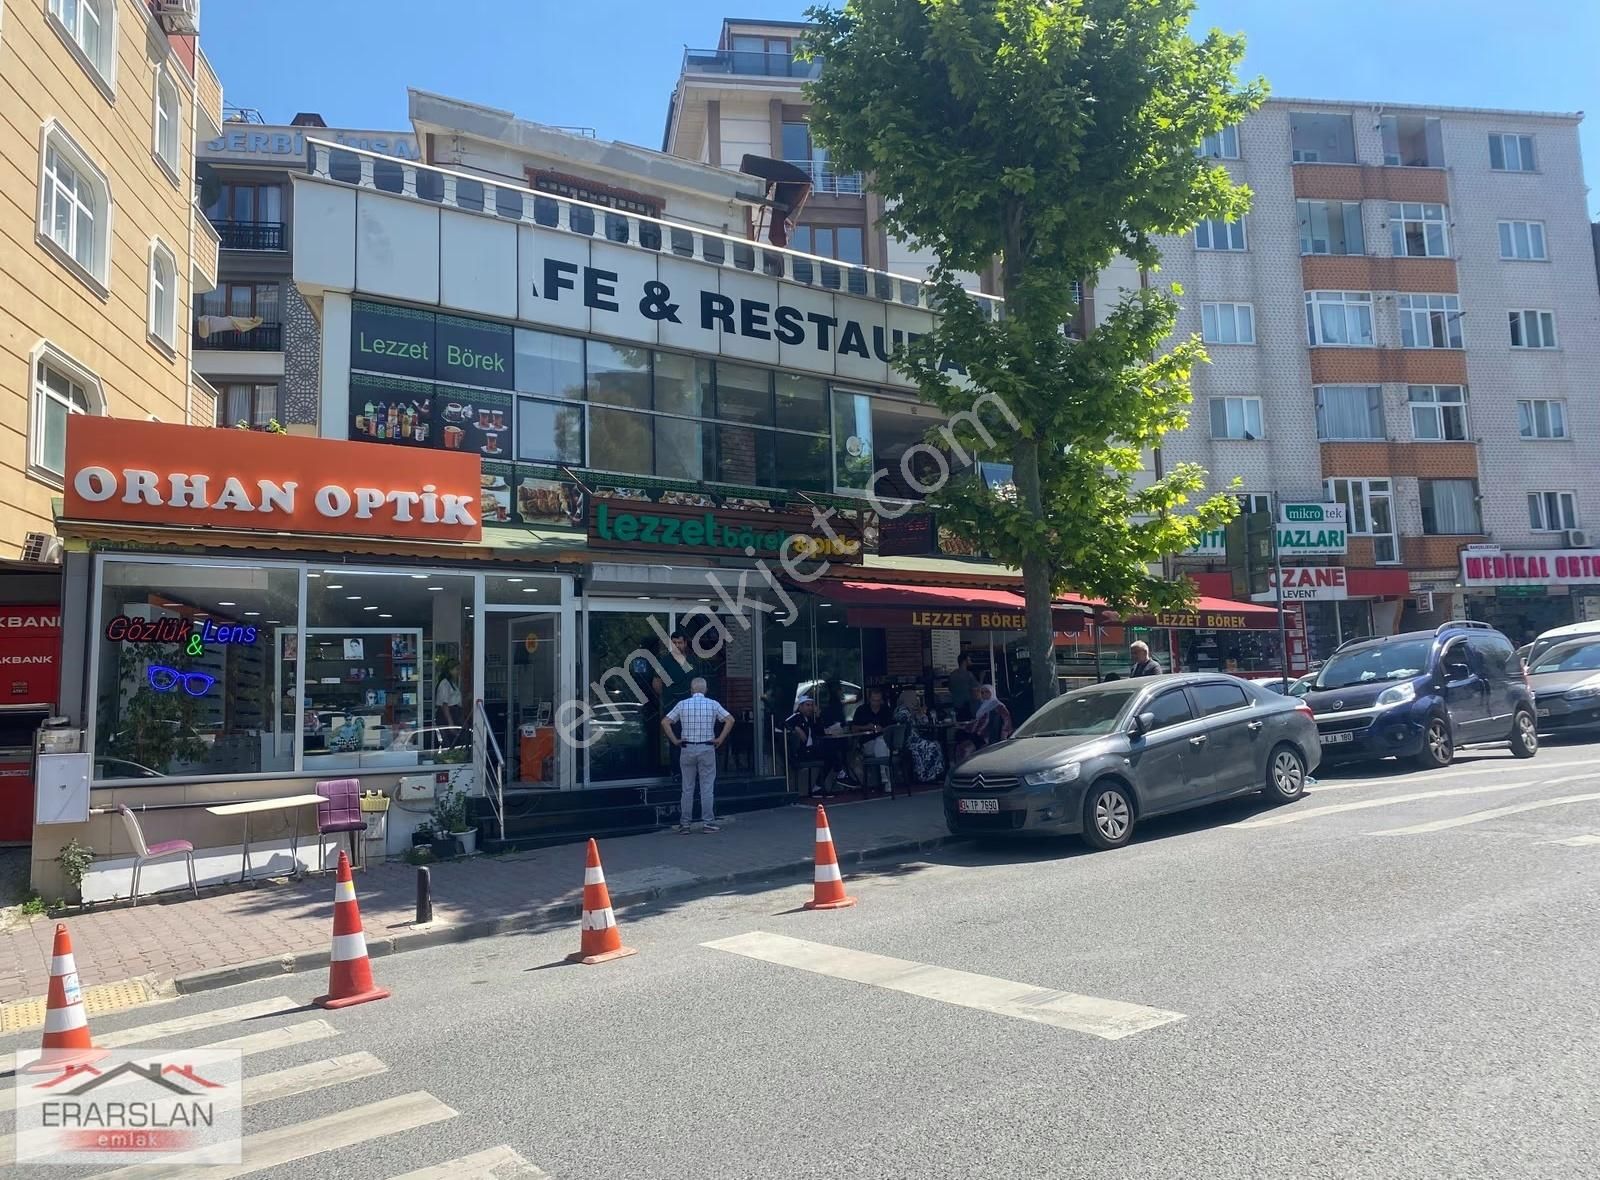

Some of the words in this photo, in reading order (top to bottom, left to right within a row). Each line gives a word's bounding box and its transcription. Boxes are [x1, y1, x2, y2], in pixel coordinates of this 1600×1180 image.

[532, 258, 619, 313] FE
[639, 280, 683, 324] &
[360, 331, 430, 361] Lezzet
[447, 344, 506, 373] Börek
[74, 466, 299, 514] ORHAN
[315, 485, 477, 527] OPTİK
[596, 503, 719, 547] lezzet
[1289, 506, 1321, 519] mikro
[1325, 506, 1343, 519] tek
[1466, 553, 1550, 579] MEDİKAL
[1283, 590, 1317, 599] LEVENT
[912, 611, 973, 627] LEZZET
[1156, 613, 1202, 627] LEZZET
[1207, 614, 1246, 628] BÖREK
[108, 617, 193, 642] Gözlük
[186, 633, 203, 656] &
[202, 619, 257, 644] Lens
[0, 655, 52, 664] KBANK
